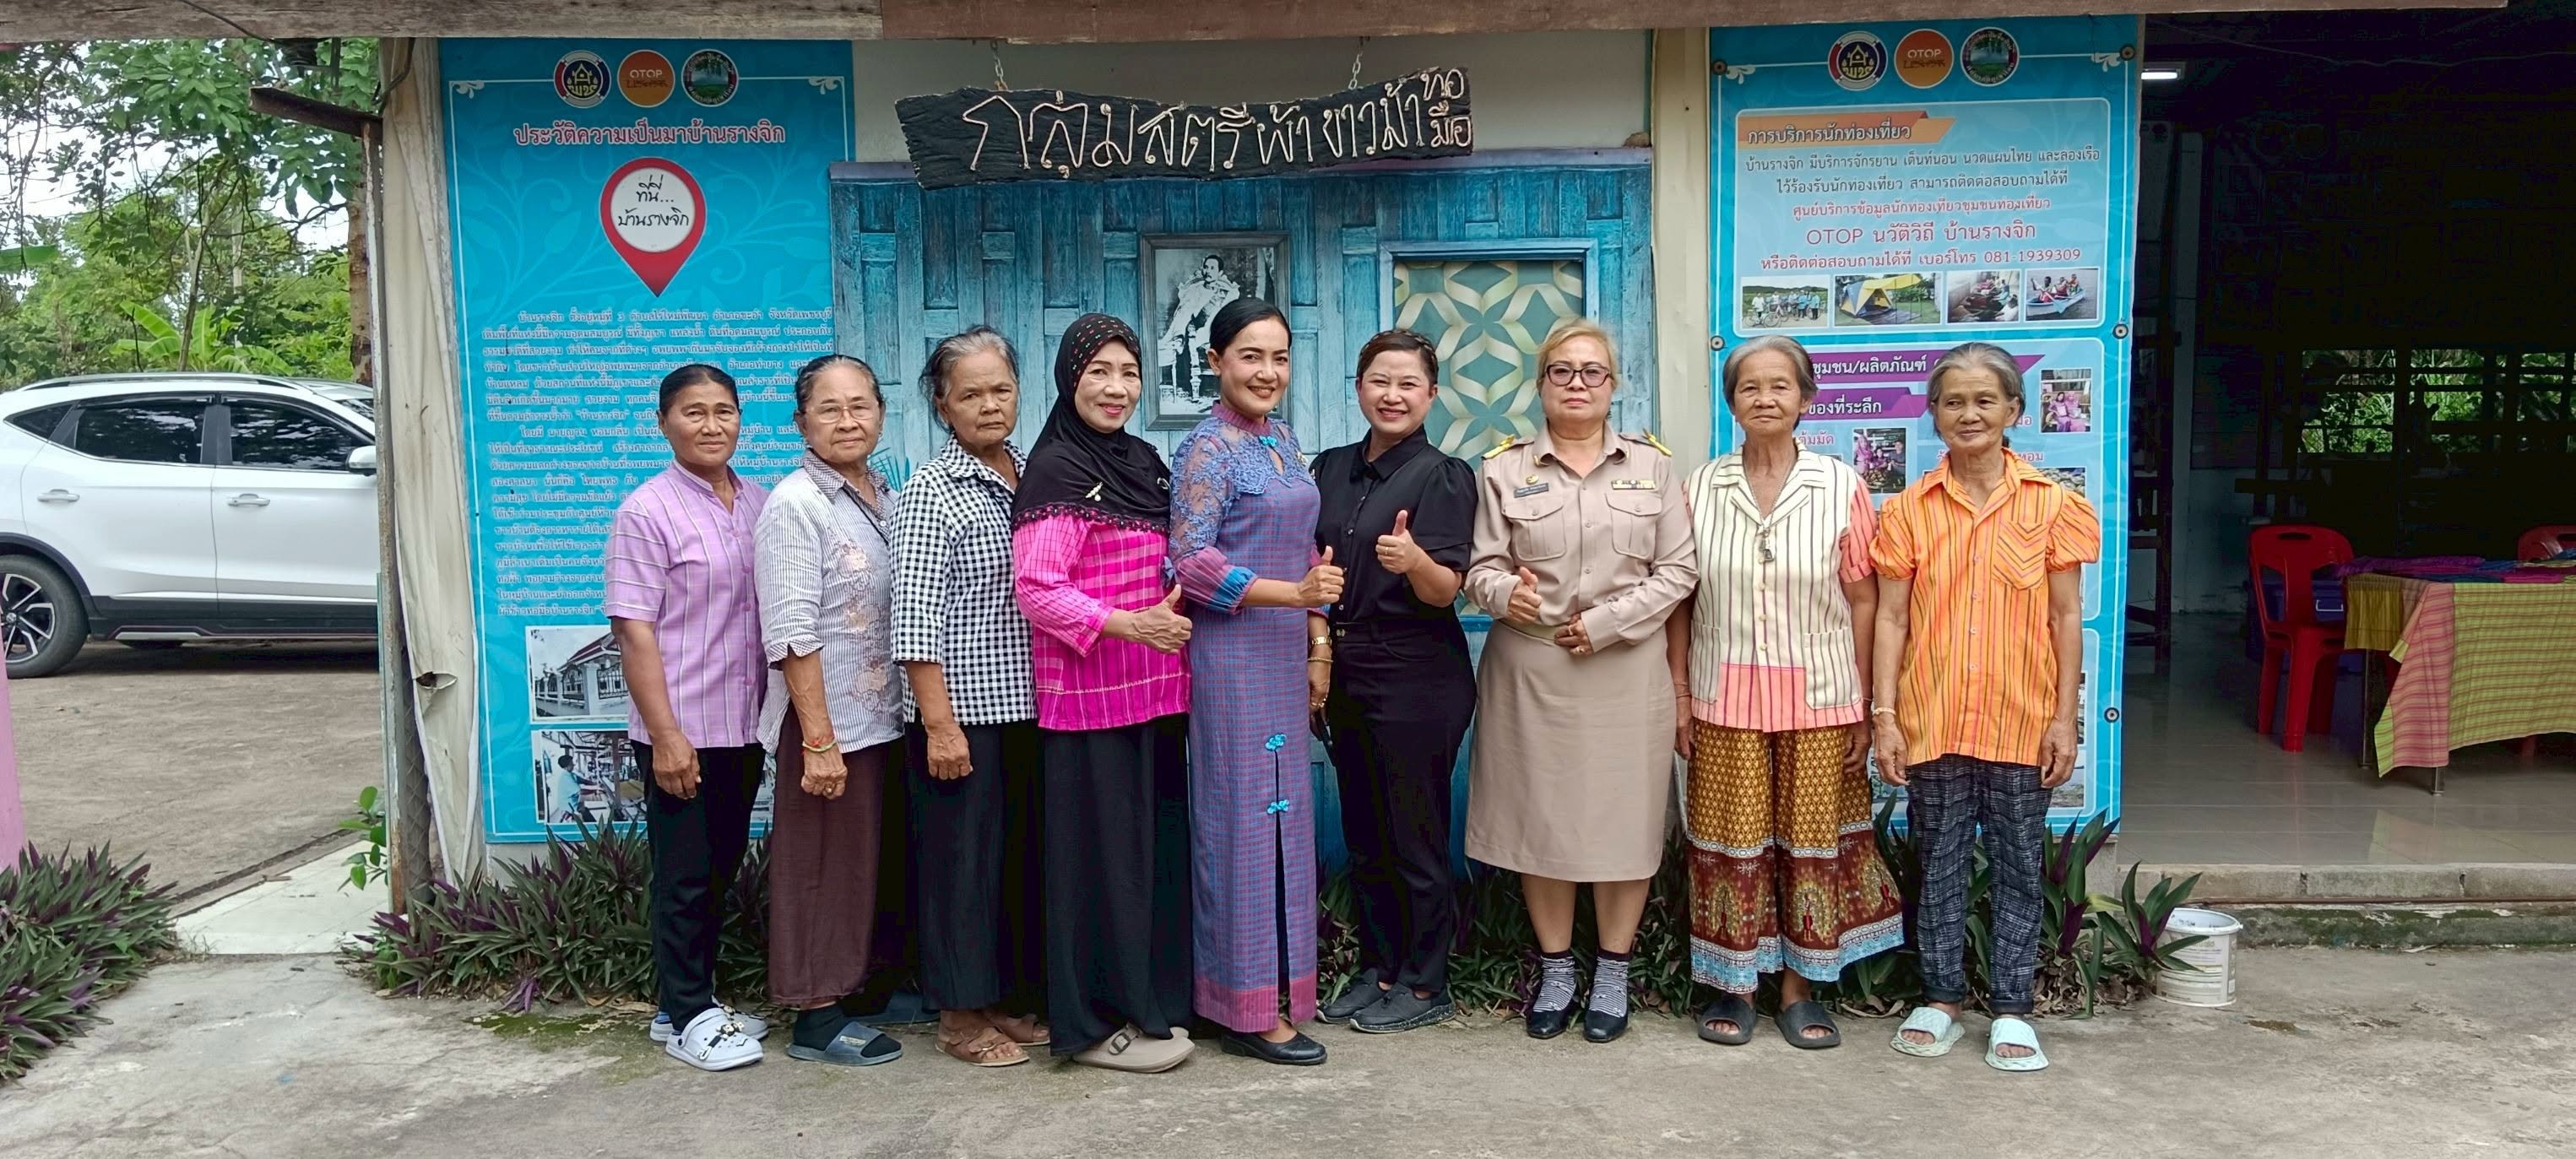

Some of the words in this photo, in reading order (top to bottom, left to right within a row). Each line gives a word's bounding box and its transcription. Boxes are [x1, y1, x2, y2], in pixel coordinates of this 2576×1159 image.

[1907, 48, 1942, 59] OTOP
[629, 69, 663, 79] OTOP
[513, 117, 785, 145] ประวัติความเป็นมาบ้านรางจิก
[1748, 116, 1912, 144] การบริการนักท่องเที่ยว
[1746, 155, 1803, 171] บ้านรางจิก
[1809, 152, 1897, 170] มีบริการจักรยาน
[1963, 148, 2032, 165] นวดแผนไทย
[1910, 167, 2068, 190] สามารถติดต่อสอบถามได้ที่
[618, 207, 689, 227] บ้านรางจิก
[1806, 228, 1863, 245] OTOP
[1944, 219, 2036, 241] บ้านรางจิก
[1761, 249, 1912, 270] หรือติดต่อสอบถามได้ที่
[1919, 247, 1977, 265] เบอร์โทร
[1984, 248, 2081, 263] 081-1939309
[1813, 355, 1928, 379] ชุมชน/ผลิตภัณฑ์
